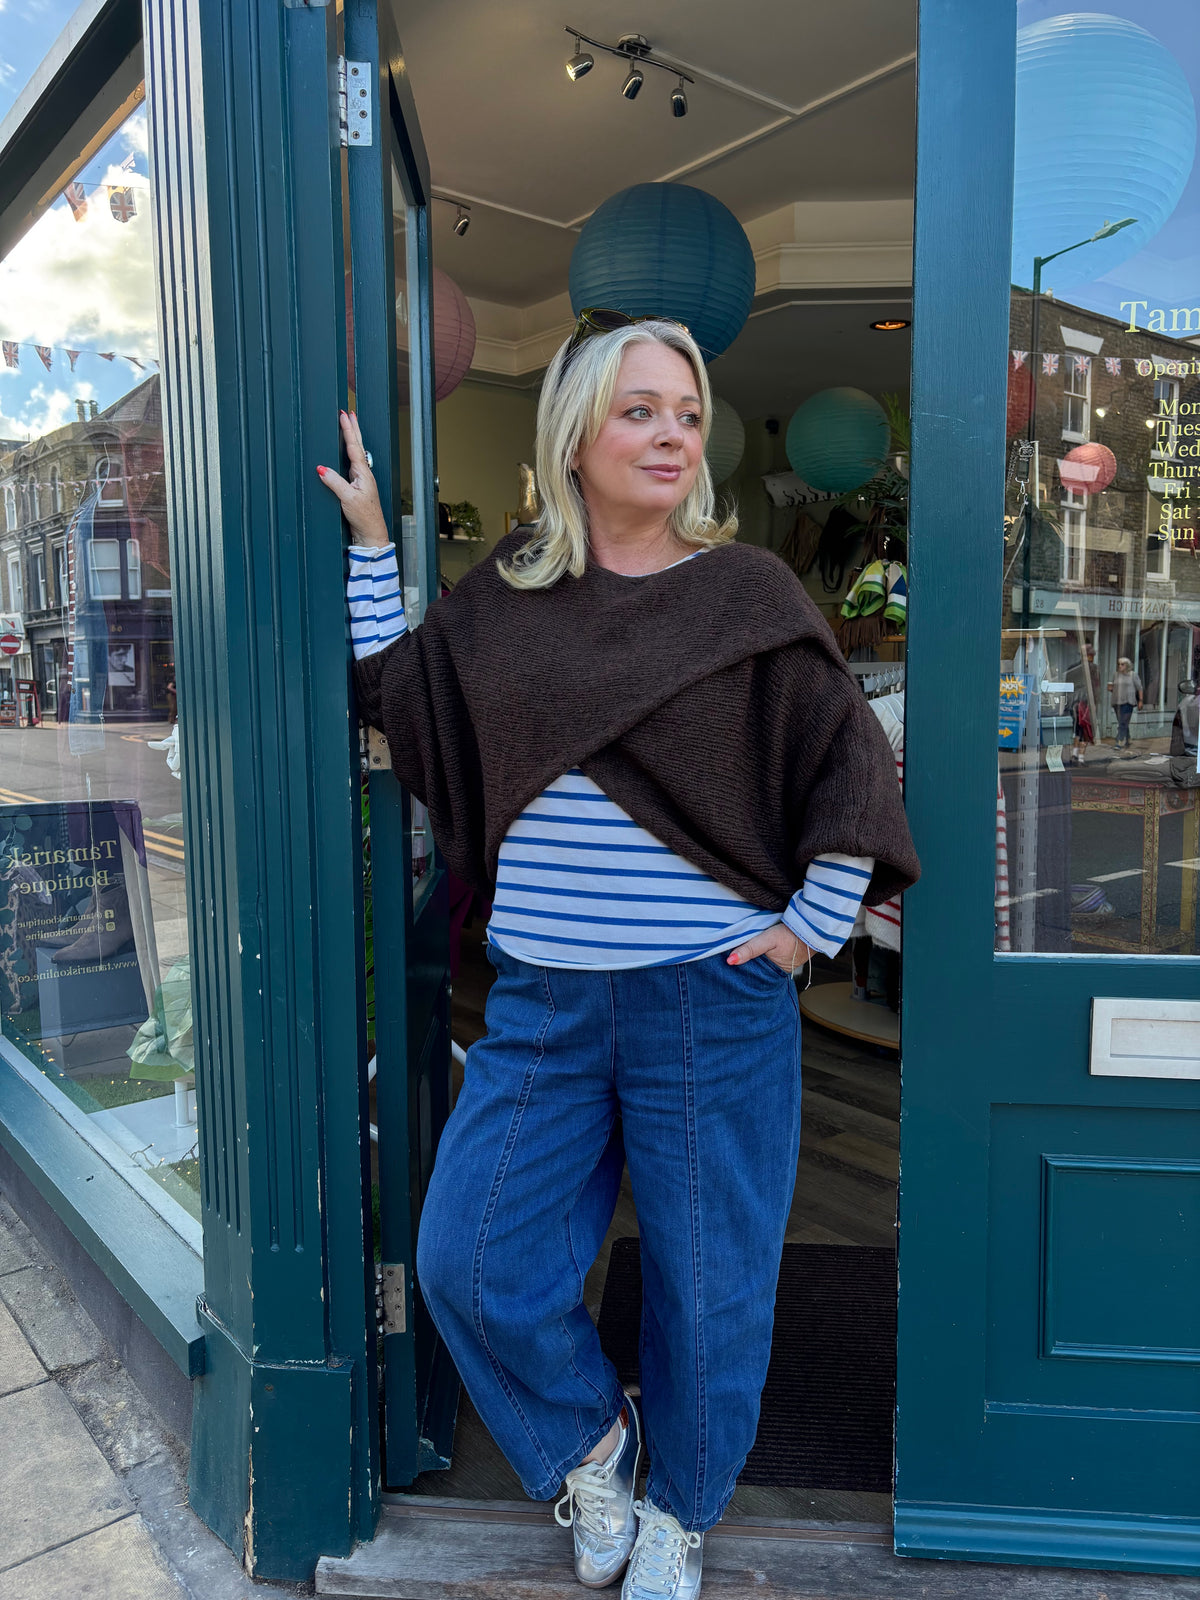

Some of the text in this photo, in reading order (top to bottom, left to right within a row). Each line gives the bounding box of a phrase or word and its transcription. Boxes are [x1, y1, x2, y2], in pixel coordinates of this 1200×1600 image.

[1137, 356, 1200, 381] Openi
[1159, 398, 1200, 416] Mon
[1156, 420, 1200, 437] Tues
[1156, 438, 1200, 458] Wed
[1162, 481, 1191, 500] Fri
[1160, 503, 1192, 520] Sat
[1157, 523, 1195, 541] Sun
